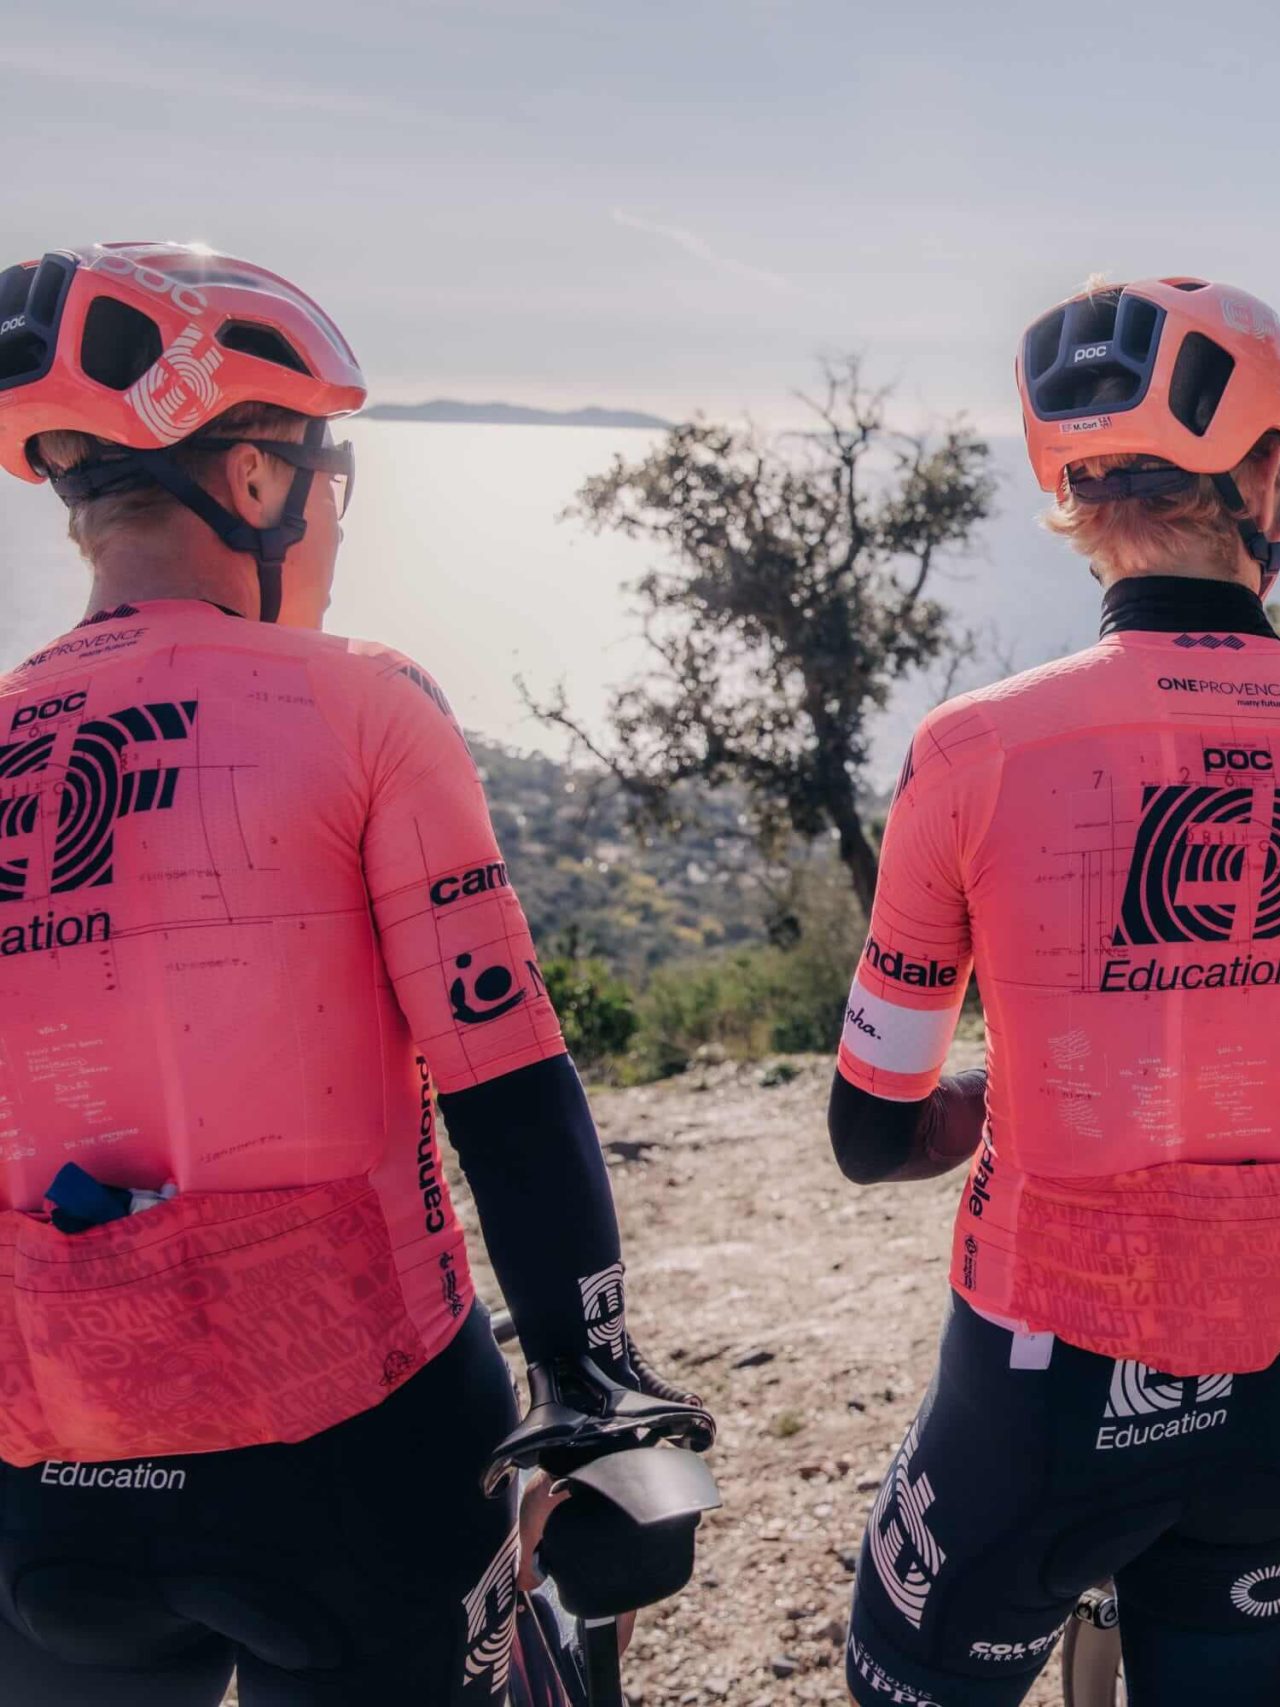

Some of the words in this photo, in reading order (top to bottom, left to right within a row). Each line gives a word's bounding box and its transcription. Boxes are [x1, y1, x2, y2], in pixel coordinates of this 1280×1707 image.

[0, 315, 25, 335] poc
[1074, 345, 1107, 363] poc
[11, 692, 87, 730] poc
[1203, 748, 1273, 773] poc
[0, 911, 112, 955] ation
[865, 937, 958, 988] ndale
[1096, 1408, 1228, 1449] Education
[40, 1460, 187, 1490] Education
